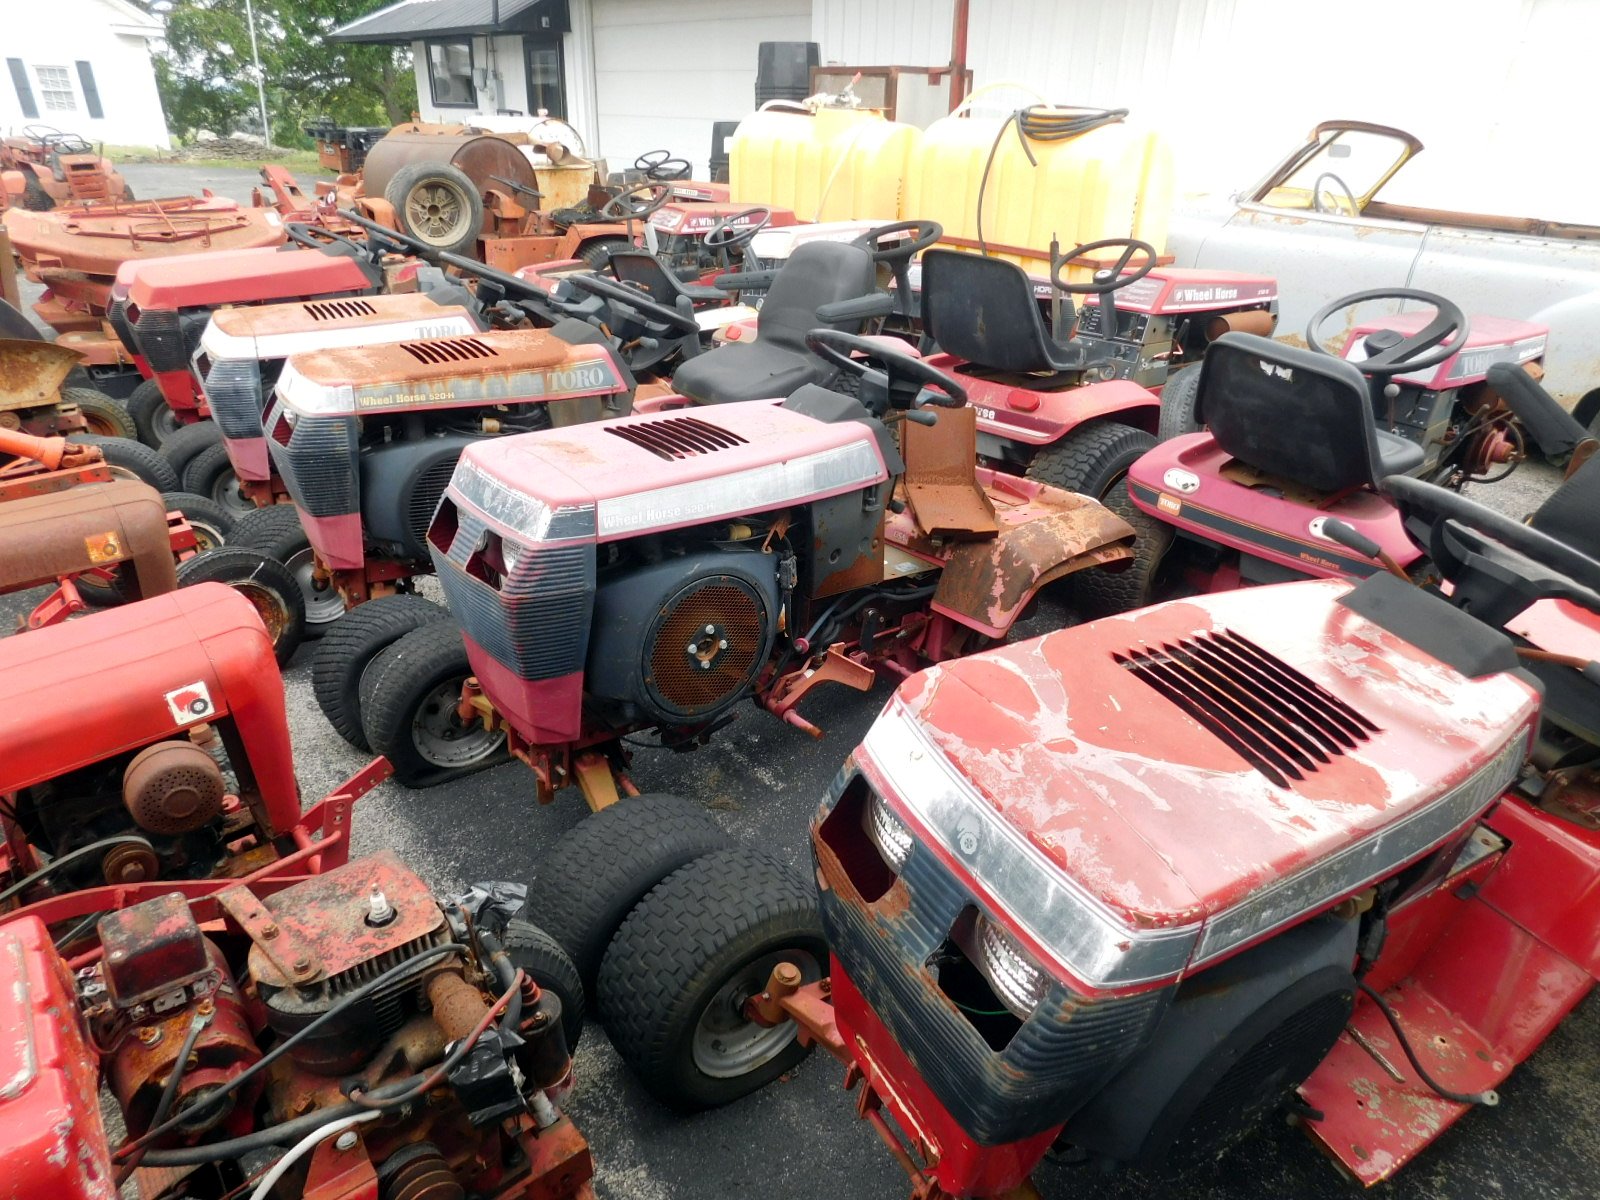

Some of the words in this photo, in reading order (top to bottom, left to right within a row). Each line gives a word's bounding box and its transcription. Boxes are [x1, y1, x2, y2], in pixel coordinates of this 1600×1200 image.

[1184, 288, 1213, 302] Wheel
[1215, 287, 1238, 300] Horse
[547, 366, 604, 391] TORO
[360, 395, 393, 406] Wheel
[396, 393, 426, 403] Horse
[429, 391, 455, 400] 520-H
[603, 511, 642, 529] Wheel
[646, 506, 681, 521] Horse
